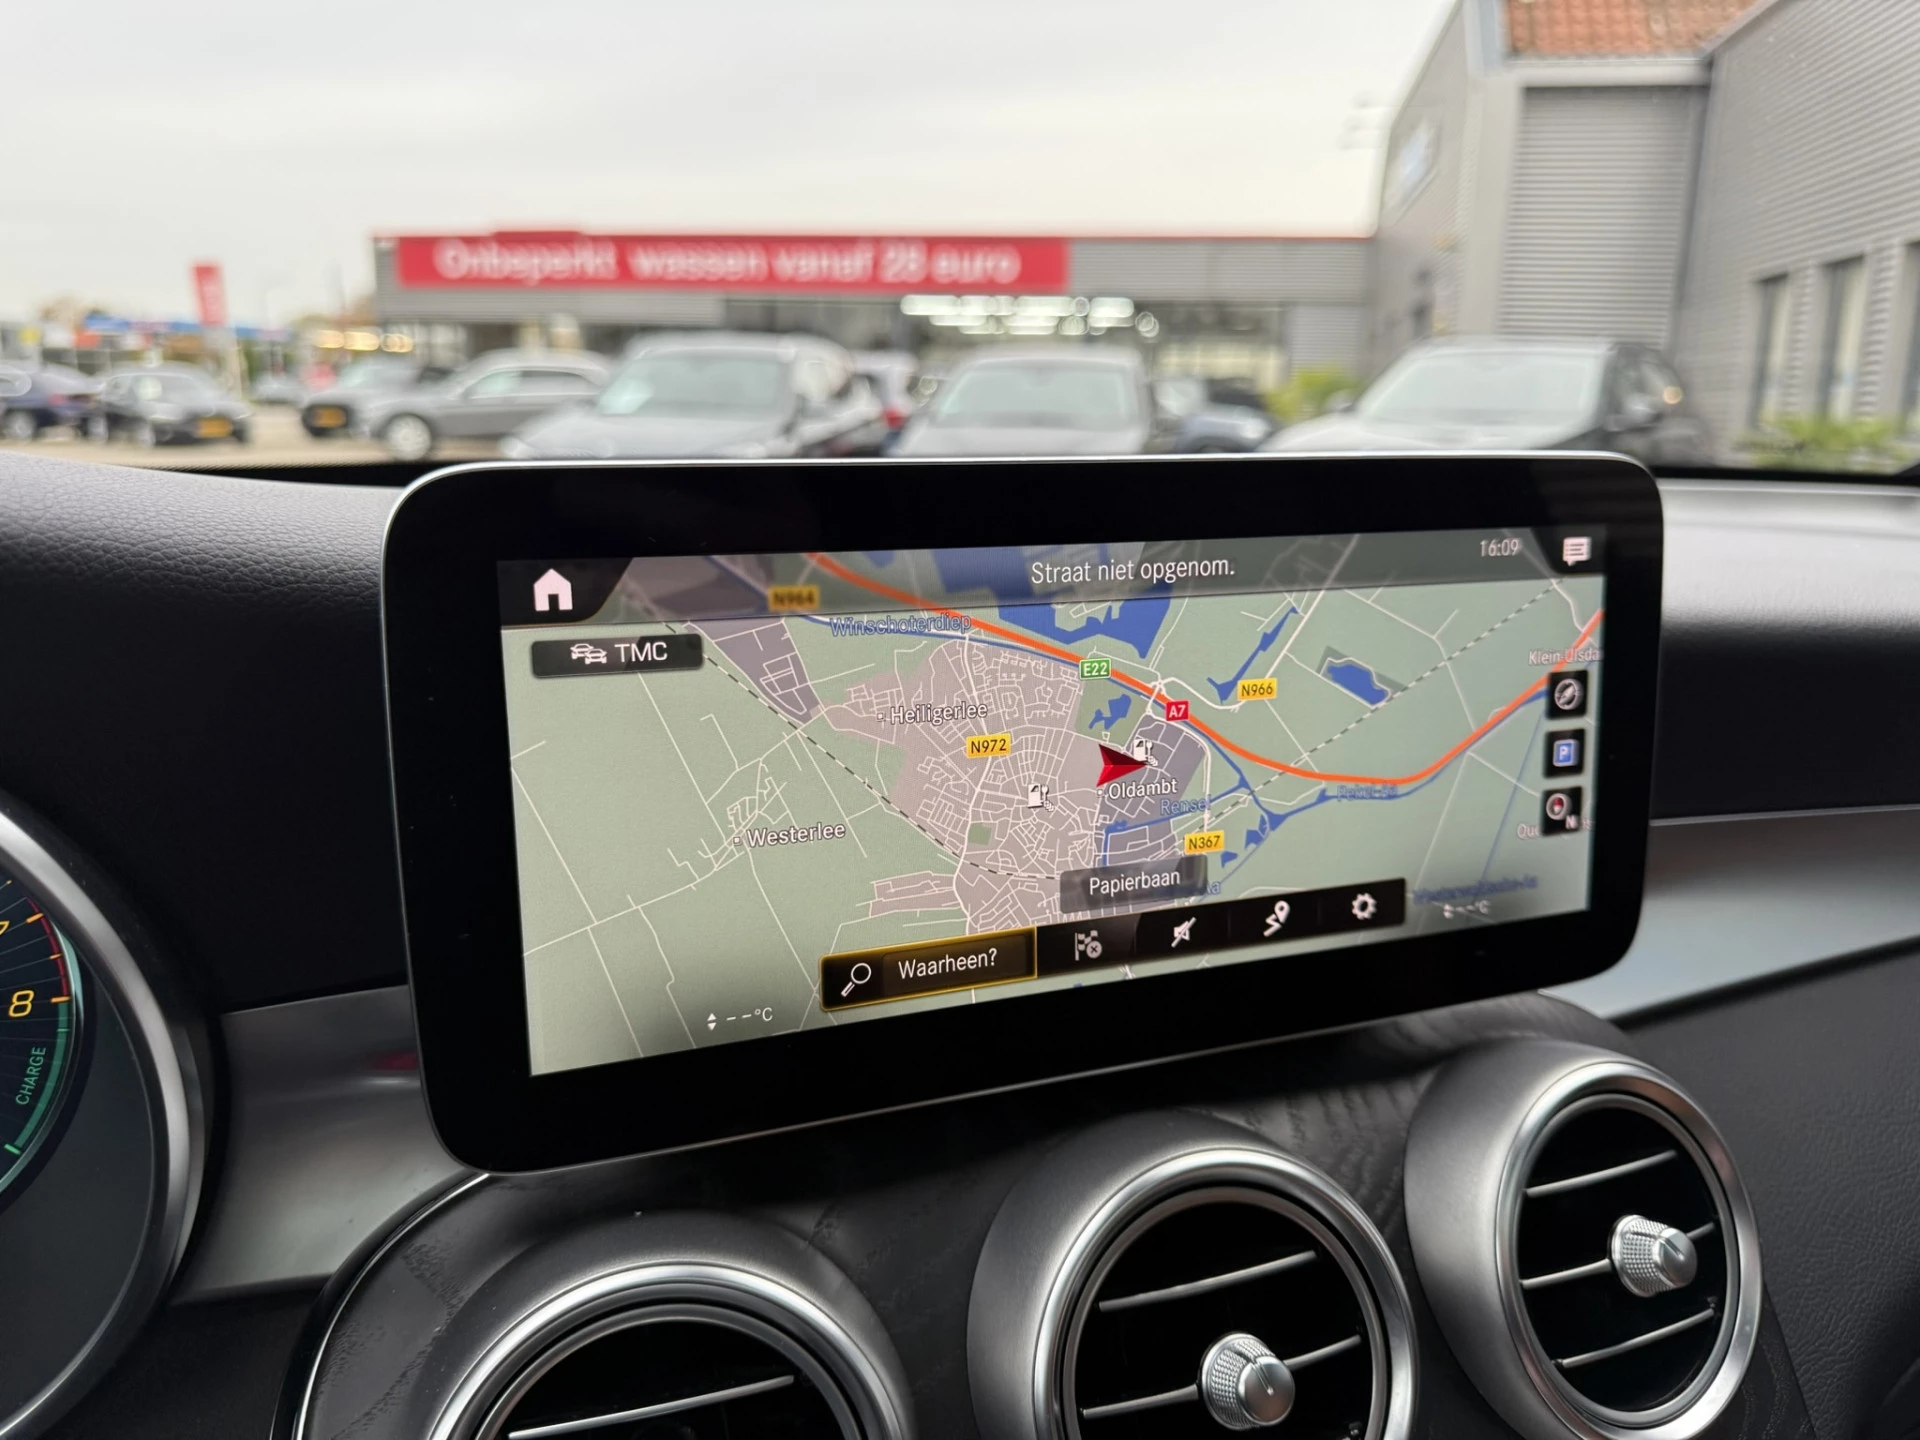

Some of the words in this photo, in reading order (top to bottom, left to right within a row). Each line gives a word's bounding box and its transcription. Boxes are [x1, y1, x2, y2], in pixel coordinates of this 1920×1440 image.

[434, 238, 619, 286] Onbeperkt
[628, 242, 769, 281] wassen
[772, 237, 876, 282] vanaf
[931, 243, 1022, 284] euro
[1479, 538, 1520, 557] 16:09
[1031, 561, 1091, 584] Straat
[1098, 559, 1134, 580] niet
[1140, 559, 1235, 583] opgenom.
[829, 614, 972, 637] Winschoterdiep
[614, 641, 668, 662] TMC
[1083, 660, 1107, 676] E22
[1241, 681, 1274, 697] N966
[890, 701, 988, 726] Heiligerlee
[1169, 704, 1186, 718] A7
[970, 738, 1007, 754] N972
[1108, 779, 1177, 799] Oldambt
[747, 823, 846, 848] Westerlee
[1188, 835, 1220, 850] N367
[1089, 871, 1180, 897] Papierbaan
[898, 948, 998, 980] Waarheen?
[8, 990, 35, 1017] 8
[15, 1047, 47, 1106] CHARGE
